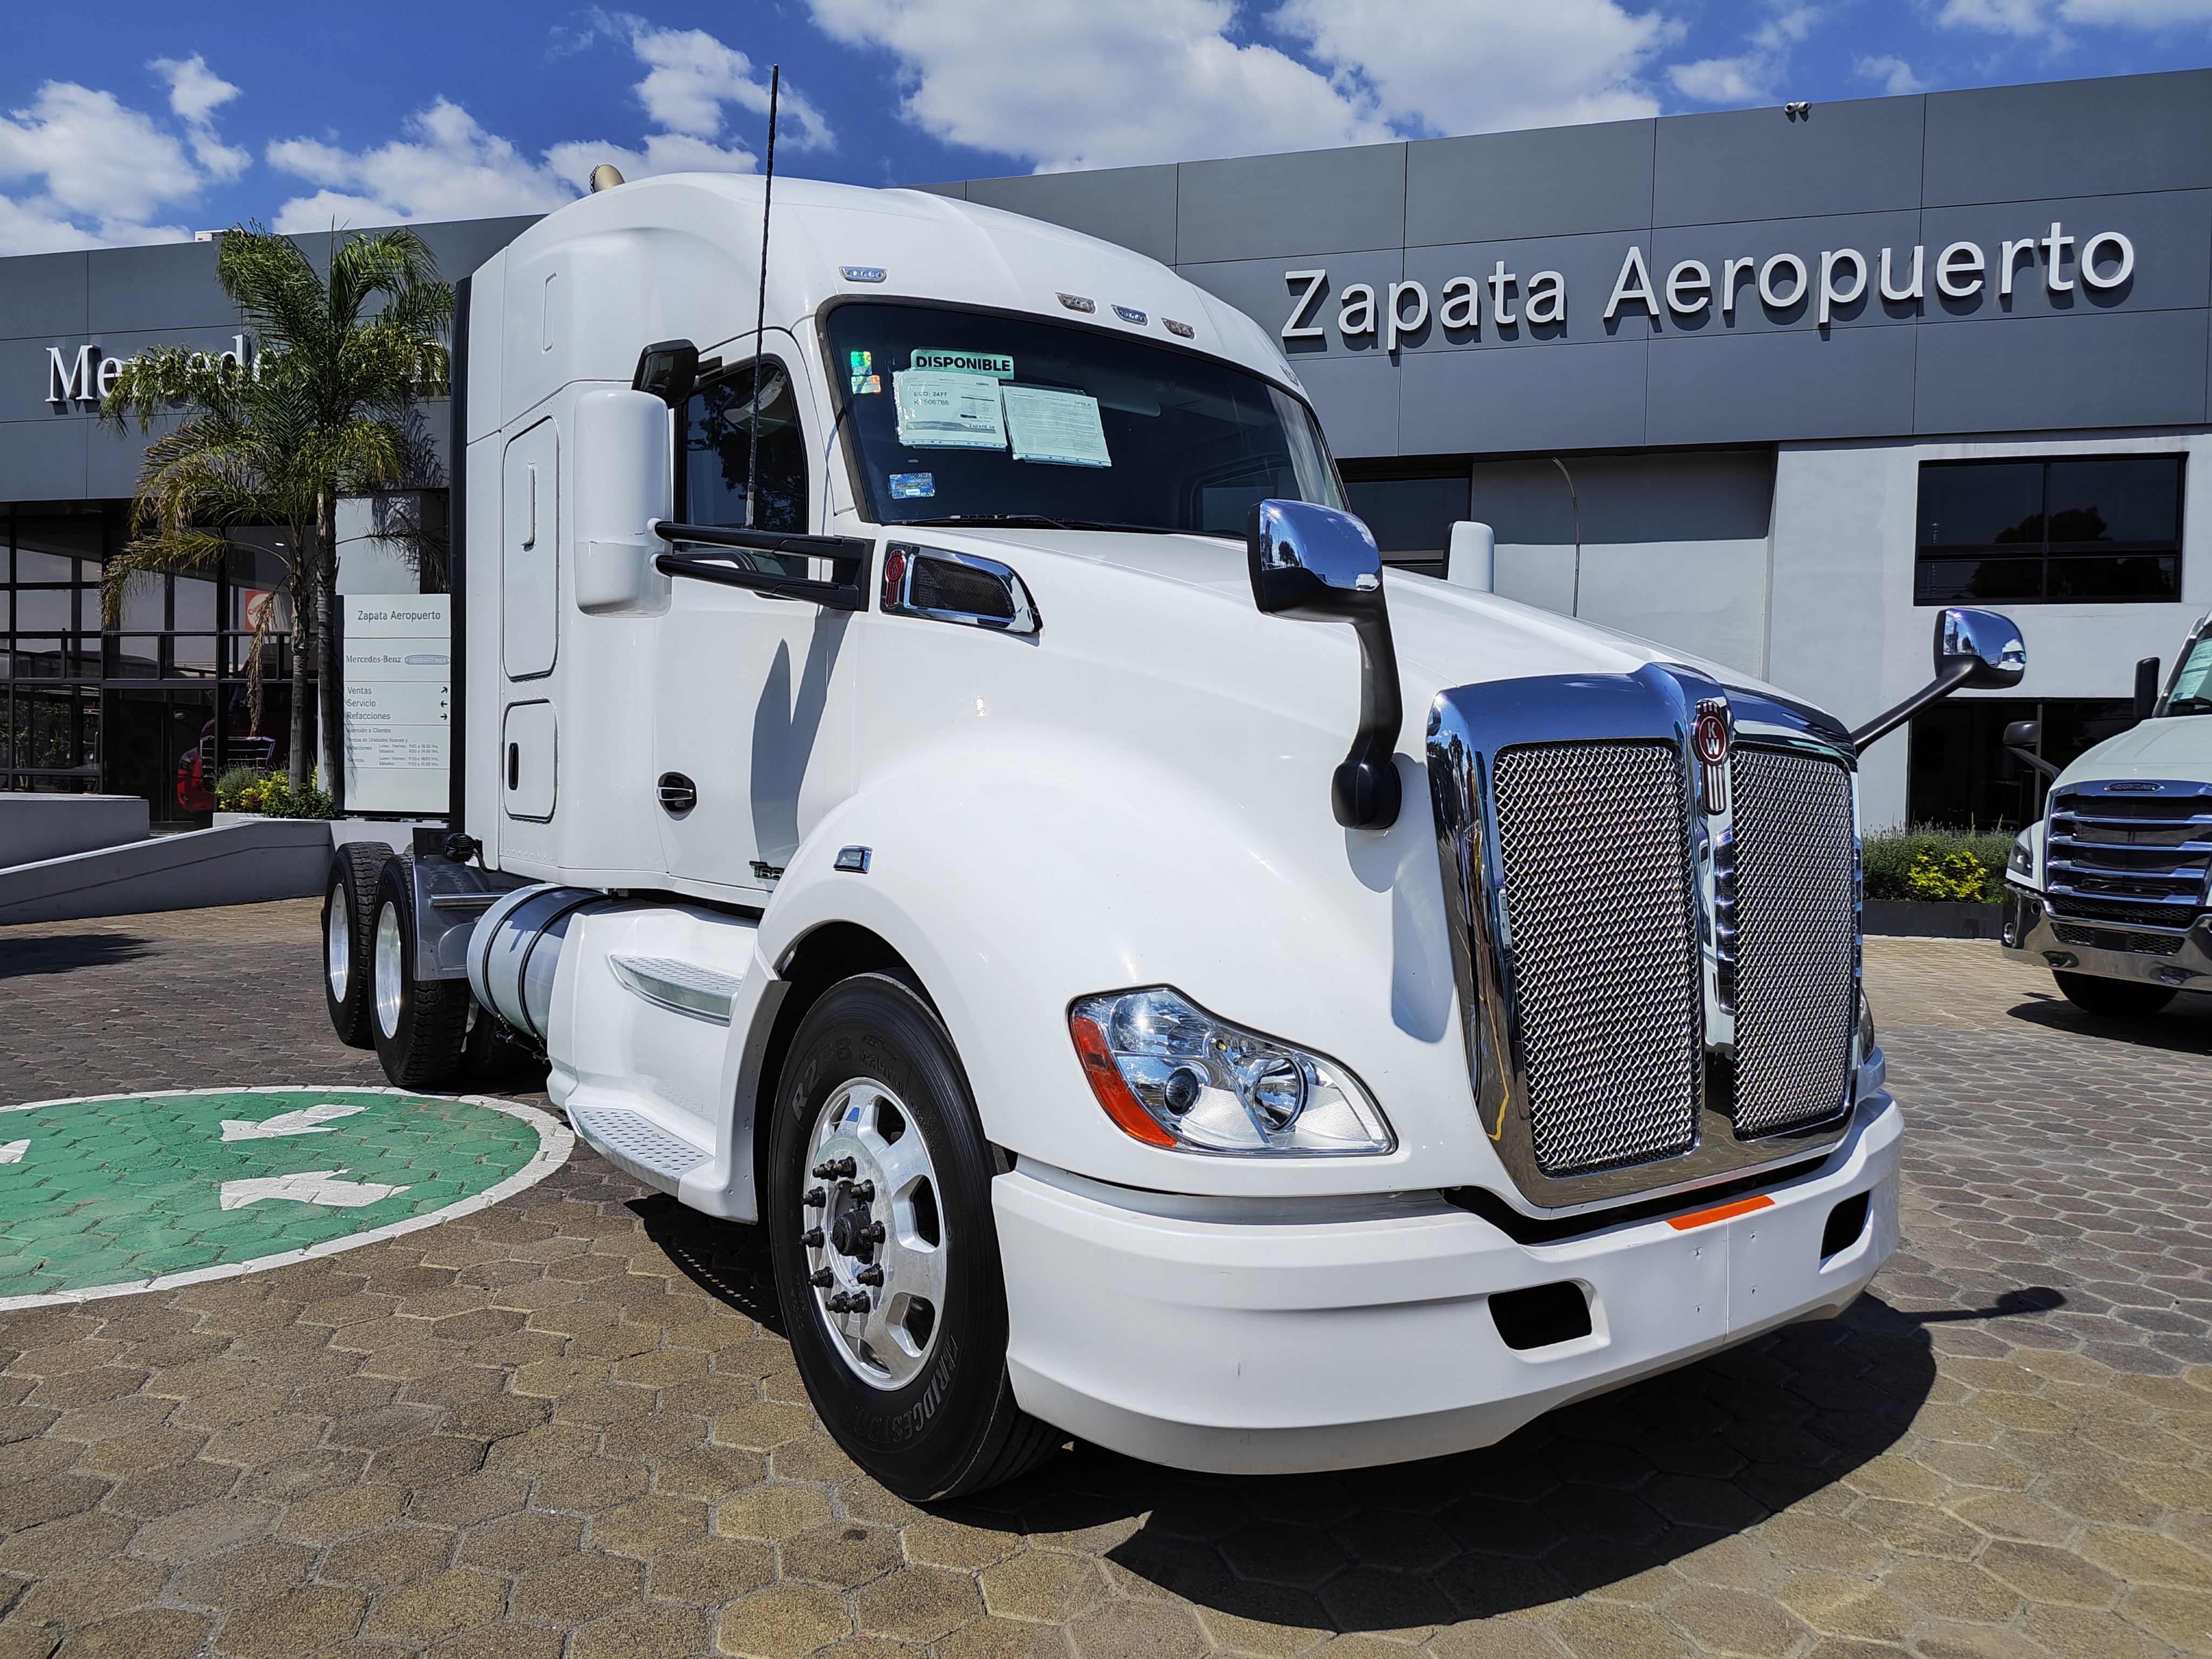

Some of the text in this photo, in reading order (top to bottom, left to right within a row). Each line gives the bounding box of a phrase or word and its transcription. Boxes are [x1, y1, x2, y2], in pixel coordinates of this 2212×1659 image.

[1281, 222, 2134, 350] Zapata Aeropuerto
[916, 356, 1011, 372] DISPONIBLE
[358, 610, 441, 624] Zapata Aeropuerto
[346, 655, 402, 663] Mercedes-Benz
[347, 686, 372, 694] Ventas
[347, 699, 376, 707] Servicio
[347, 712, 391, 720] Refacciones
[749, 860, 784, 881] T68
[791, 1035, 853, 1122] R268
